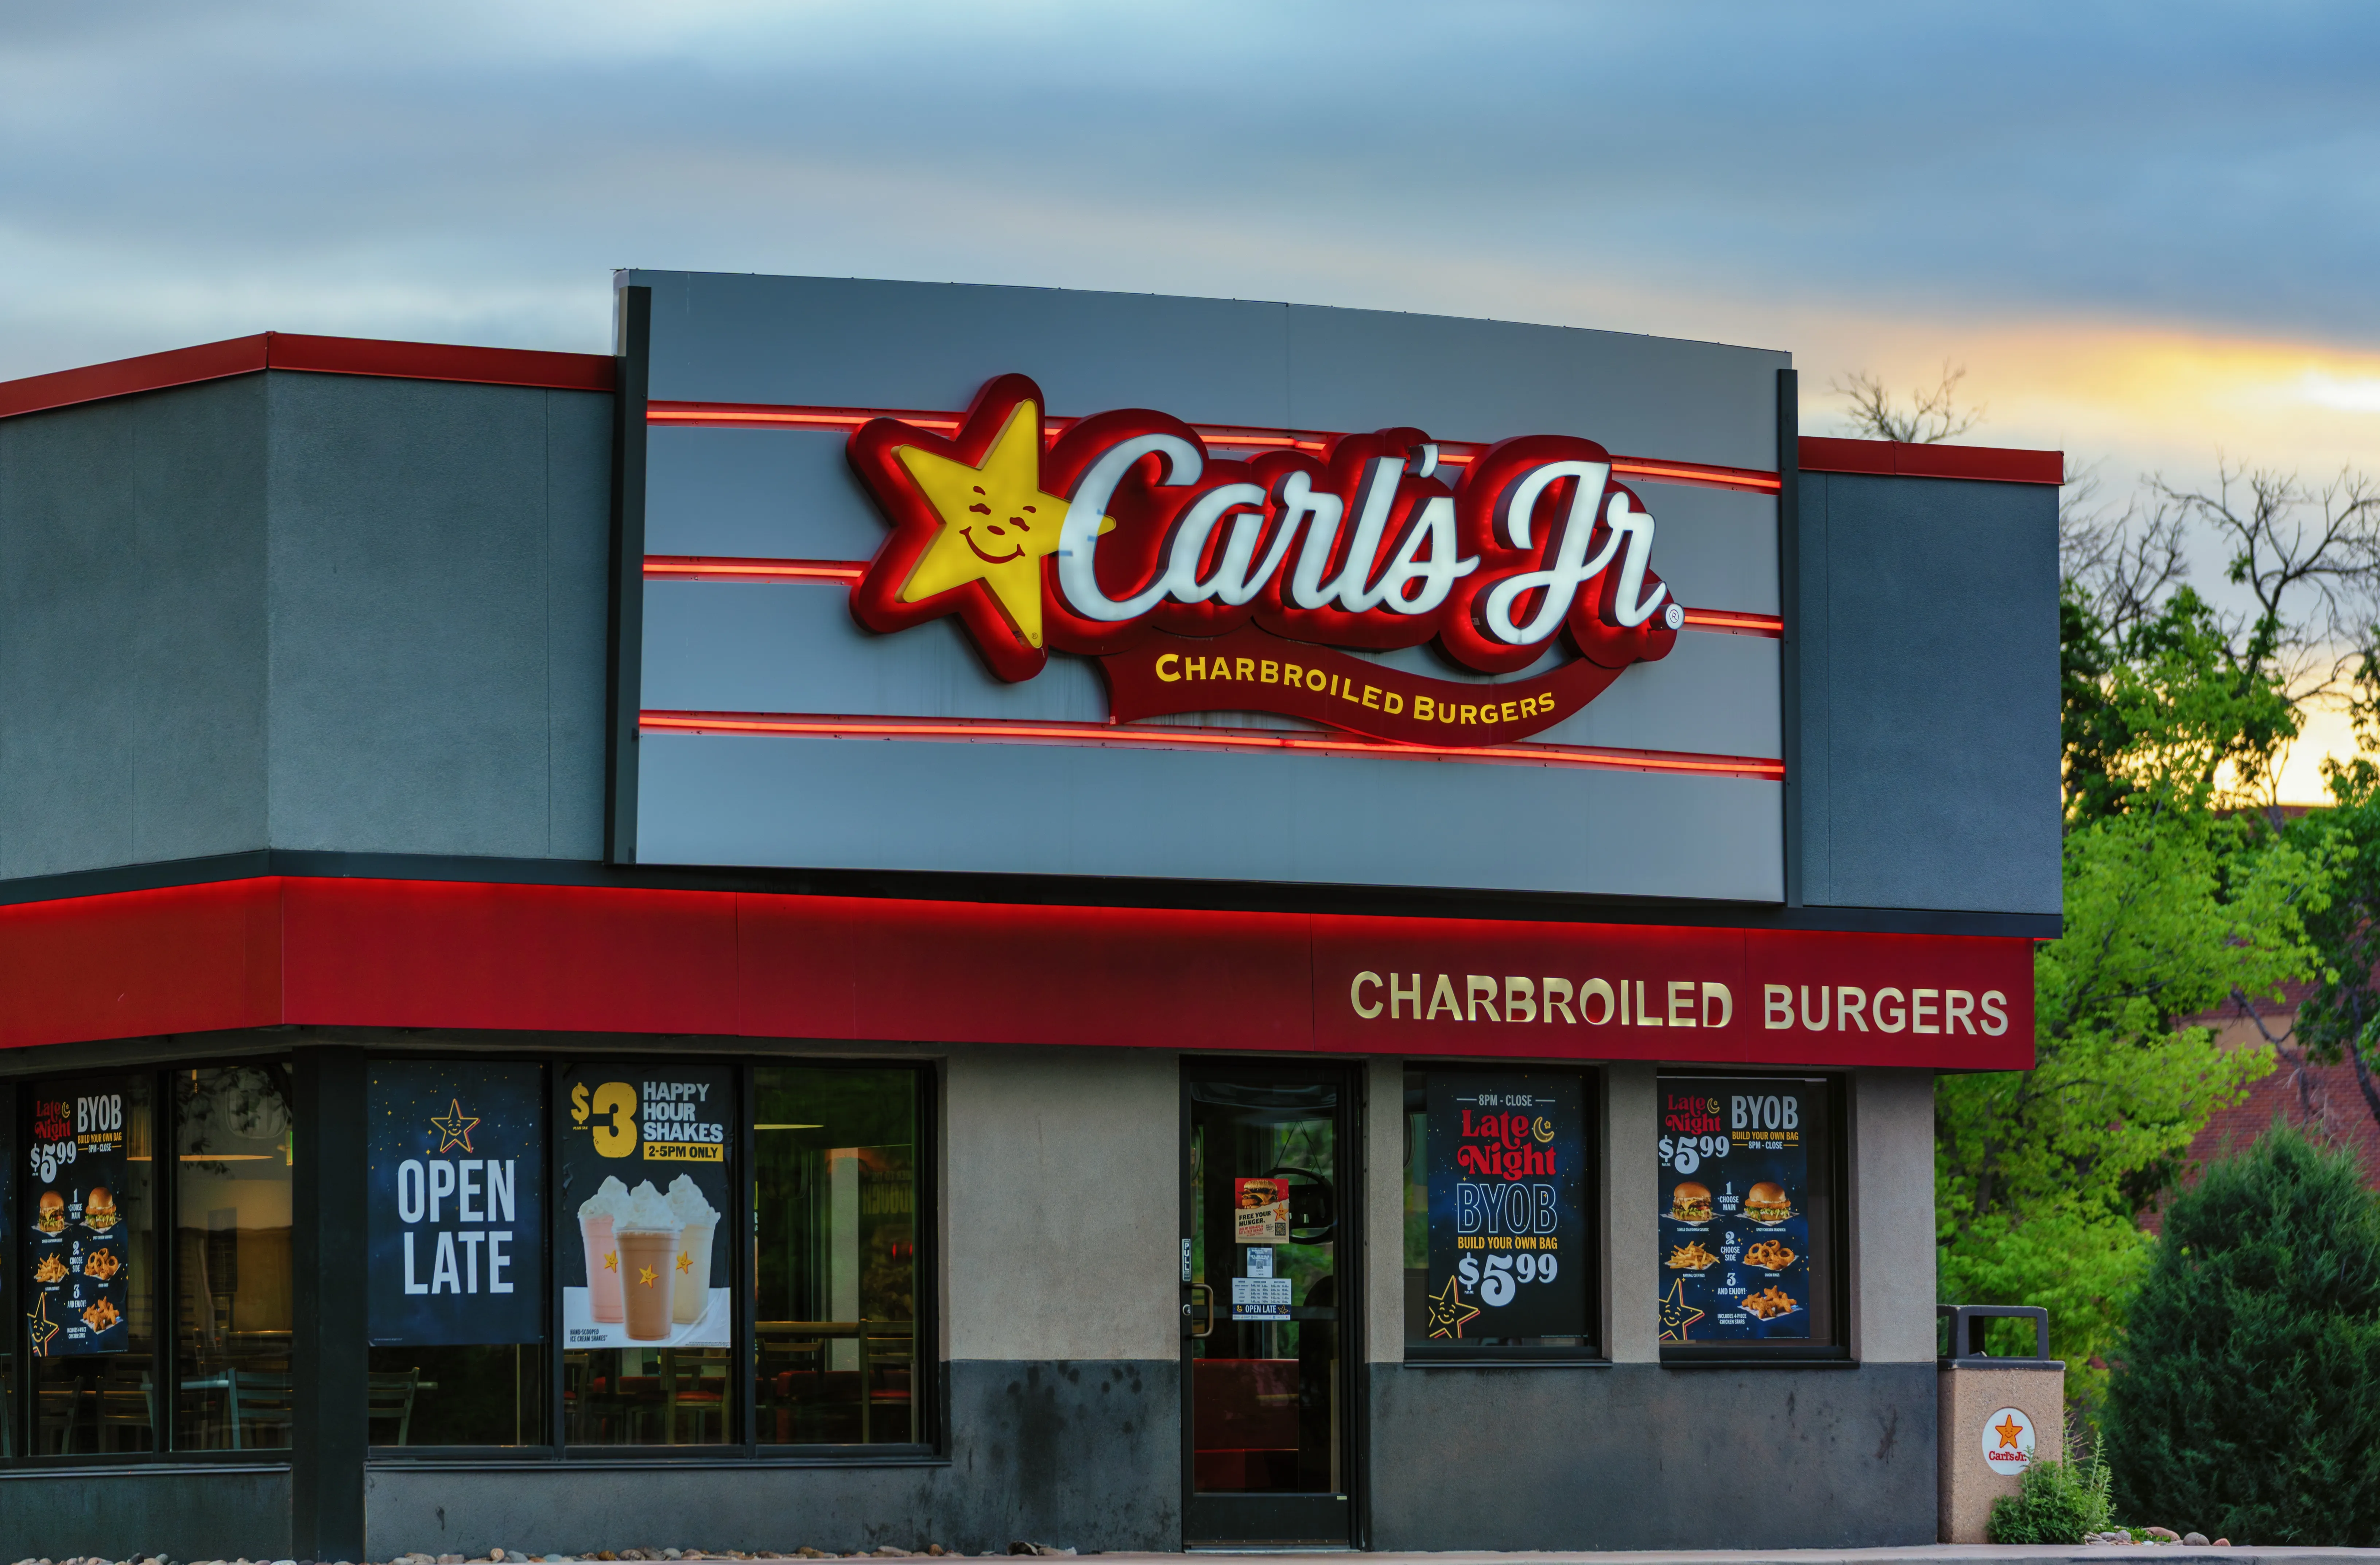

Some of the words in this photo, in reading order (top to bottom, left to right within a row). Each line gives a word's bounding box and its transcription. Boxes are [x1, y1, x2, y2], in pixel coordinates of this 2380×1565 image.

[1058, 433, 1481, 621] Carl's
[1481, 460, 1685, 646] Jr.
[1155, 653, 1403, 715] CHARBROILED
[1413, 692, 1555, 725] BURGERS
[1350, 971, 1733, 1028] CHARBROILED
[1764, 984, 2008, 1036] BURGERS
[643, 1081, 710, 1101] HAPPY
[1479, 1094, 1497, 1106] 8PM
[1505, 1095, 1532, 1106] CLOSE
[1668, 1094, 1705, 1117] Late
[36, 1100, 61, 1123] Late
[78, 1094, 122, 1133] BYOB
[643, 1102, 695, 1121] HOUR
[1732, 1095, 1798, 1129] BYOB
[571, 1082, 637, 1158] $3
[1665, 1113, 1721, 1135] Night
[35, 1118, 71, 1141] Night
[643, 1121, 724, 1143] SHAKES
[1462, 1109, 1529, 1149] Late
[1732, 1131, 1750, 1140] BUILD
[1752, 1132, 1768, 1140] YOUR
[1770, 1132, 1784, 1140] OWN
[1786, 1132, 1798, 1140] BAG
[78, 1135, 90, 1144] BUILD
[91, 1133, 102, 1143] YOUR
[102, 1133, 113, 1142] OWN
[113, 1132, 122, 1141] BAG
[1765, 1141, 1783, 1149] CLOSE
[88, 1144, 97, 1153] 8PM
[100, 1143, 111, 1152] CLOSE
[648, 1145, 686, 1157] 2-5PM
[689, 1146, 718, 1158] ONLY
[1457, 1142, 1556, 1181] Night
[73, 1188, 78, 1203] 1
[398, 1159, 515, 1223] OPEN
[1726, 1181, 1732, 1195] 1
[69, 1203, 82, 1212] CHOOSE
[1457, 1183, 1557, 1234] BYOB
[71, 1212, 80, 1220] MAIN
[1239, 1218, 1265, 1226] HUNGER.
[1458, 1236, 1485, 1249] BUILD
[1488, 1237, 1512, 1249] YOUR
[1515, 1237, 1536, 1249] OWN
[1539, 1237, 1558, 1249] BAG
[1725, 1231, 1734, 1245] 2
[73, 1241, 80, 1256] 2
[70, 1256, 83, 1265] CHOOSE
[404, 1230, 513, 1295] LATE
[1727, 1272, 1736, 1286] 3
[73, 1284, 80, 1299] 3
[1245, 1305, 1261, 1313] OPEN
[1263, 1305, 1276, 1313] LATE
[1989, 1451, 2014, 1461] Carl's
[2015, 1452, 2027, 1461] Jr.
